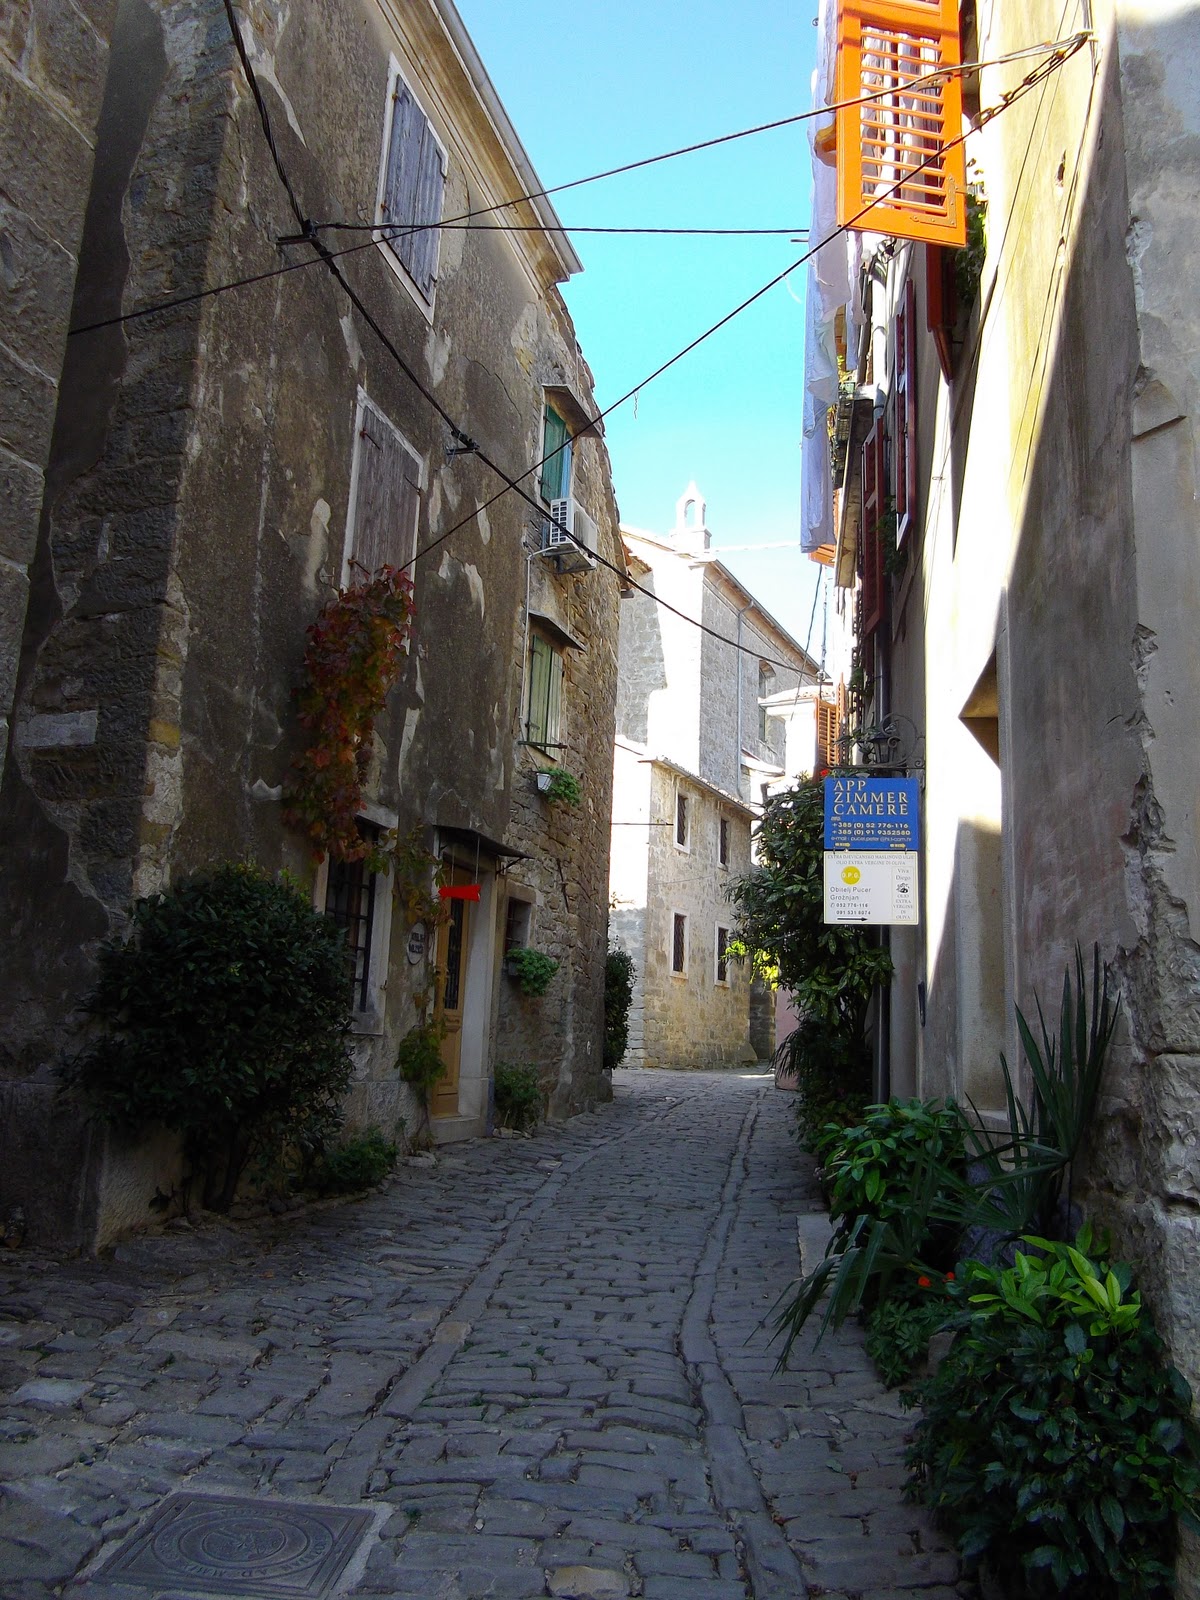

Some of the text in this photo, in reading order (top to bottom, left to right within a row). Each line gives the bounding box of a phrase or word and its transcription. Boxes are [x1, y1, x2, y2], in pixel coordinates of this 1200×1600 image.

[833, 780, 866, 791] APP
[833, 791, 909, 803] ZIMMER
[833, 803, 909, 816] CAMERE
